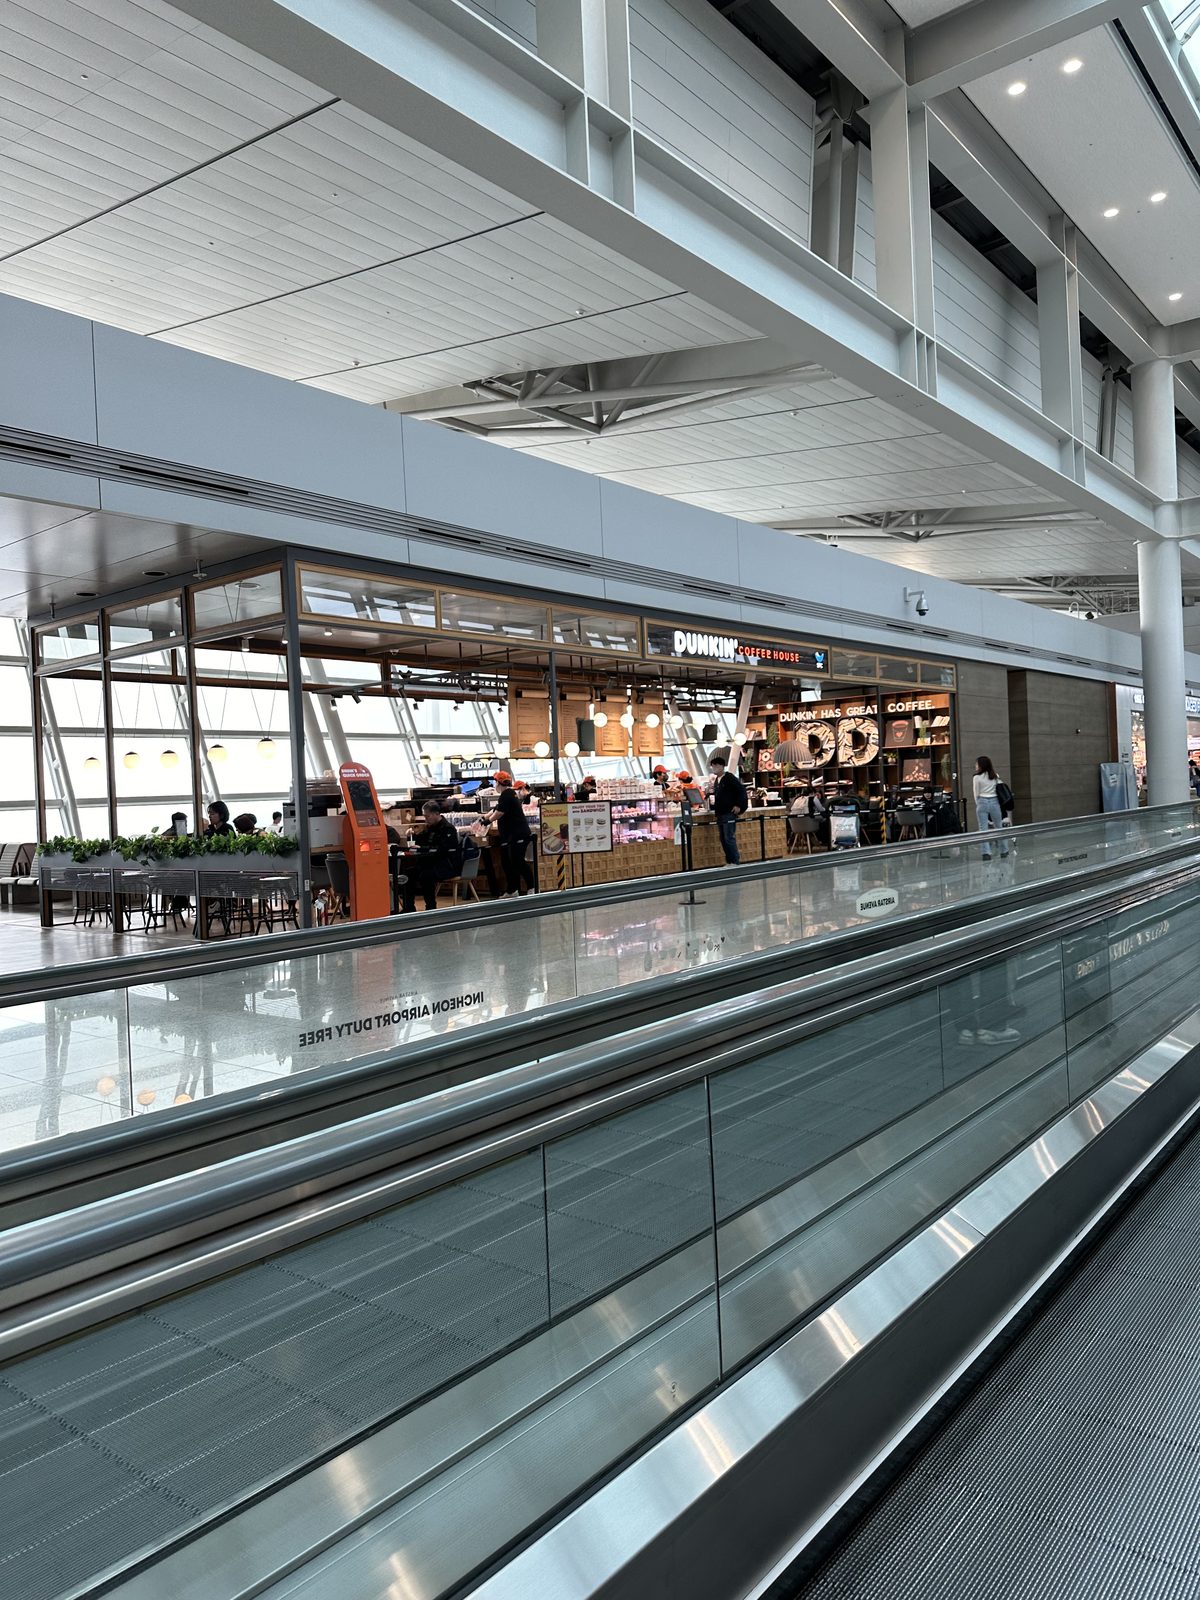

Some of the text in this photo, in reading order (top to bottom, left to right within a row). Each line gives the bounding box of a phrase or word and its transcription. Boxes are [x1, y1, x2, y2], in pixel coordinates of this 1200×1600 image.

[673, 630, 800, 662] DUNKIN' COFFEE HOUSE
[780, 710, 817, 722] DUNKIN'
[821, 708, 842, 719] HAS
[846, 704, 879, 717] GREAT
[458, 762, 467, 770] LG
[468, 761, 482, 769] OLED
